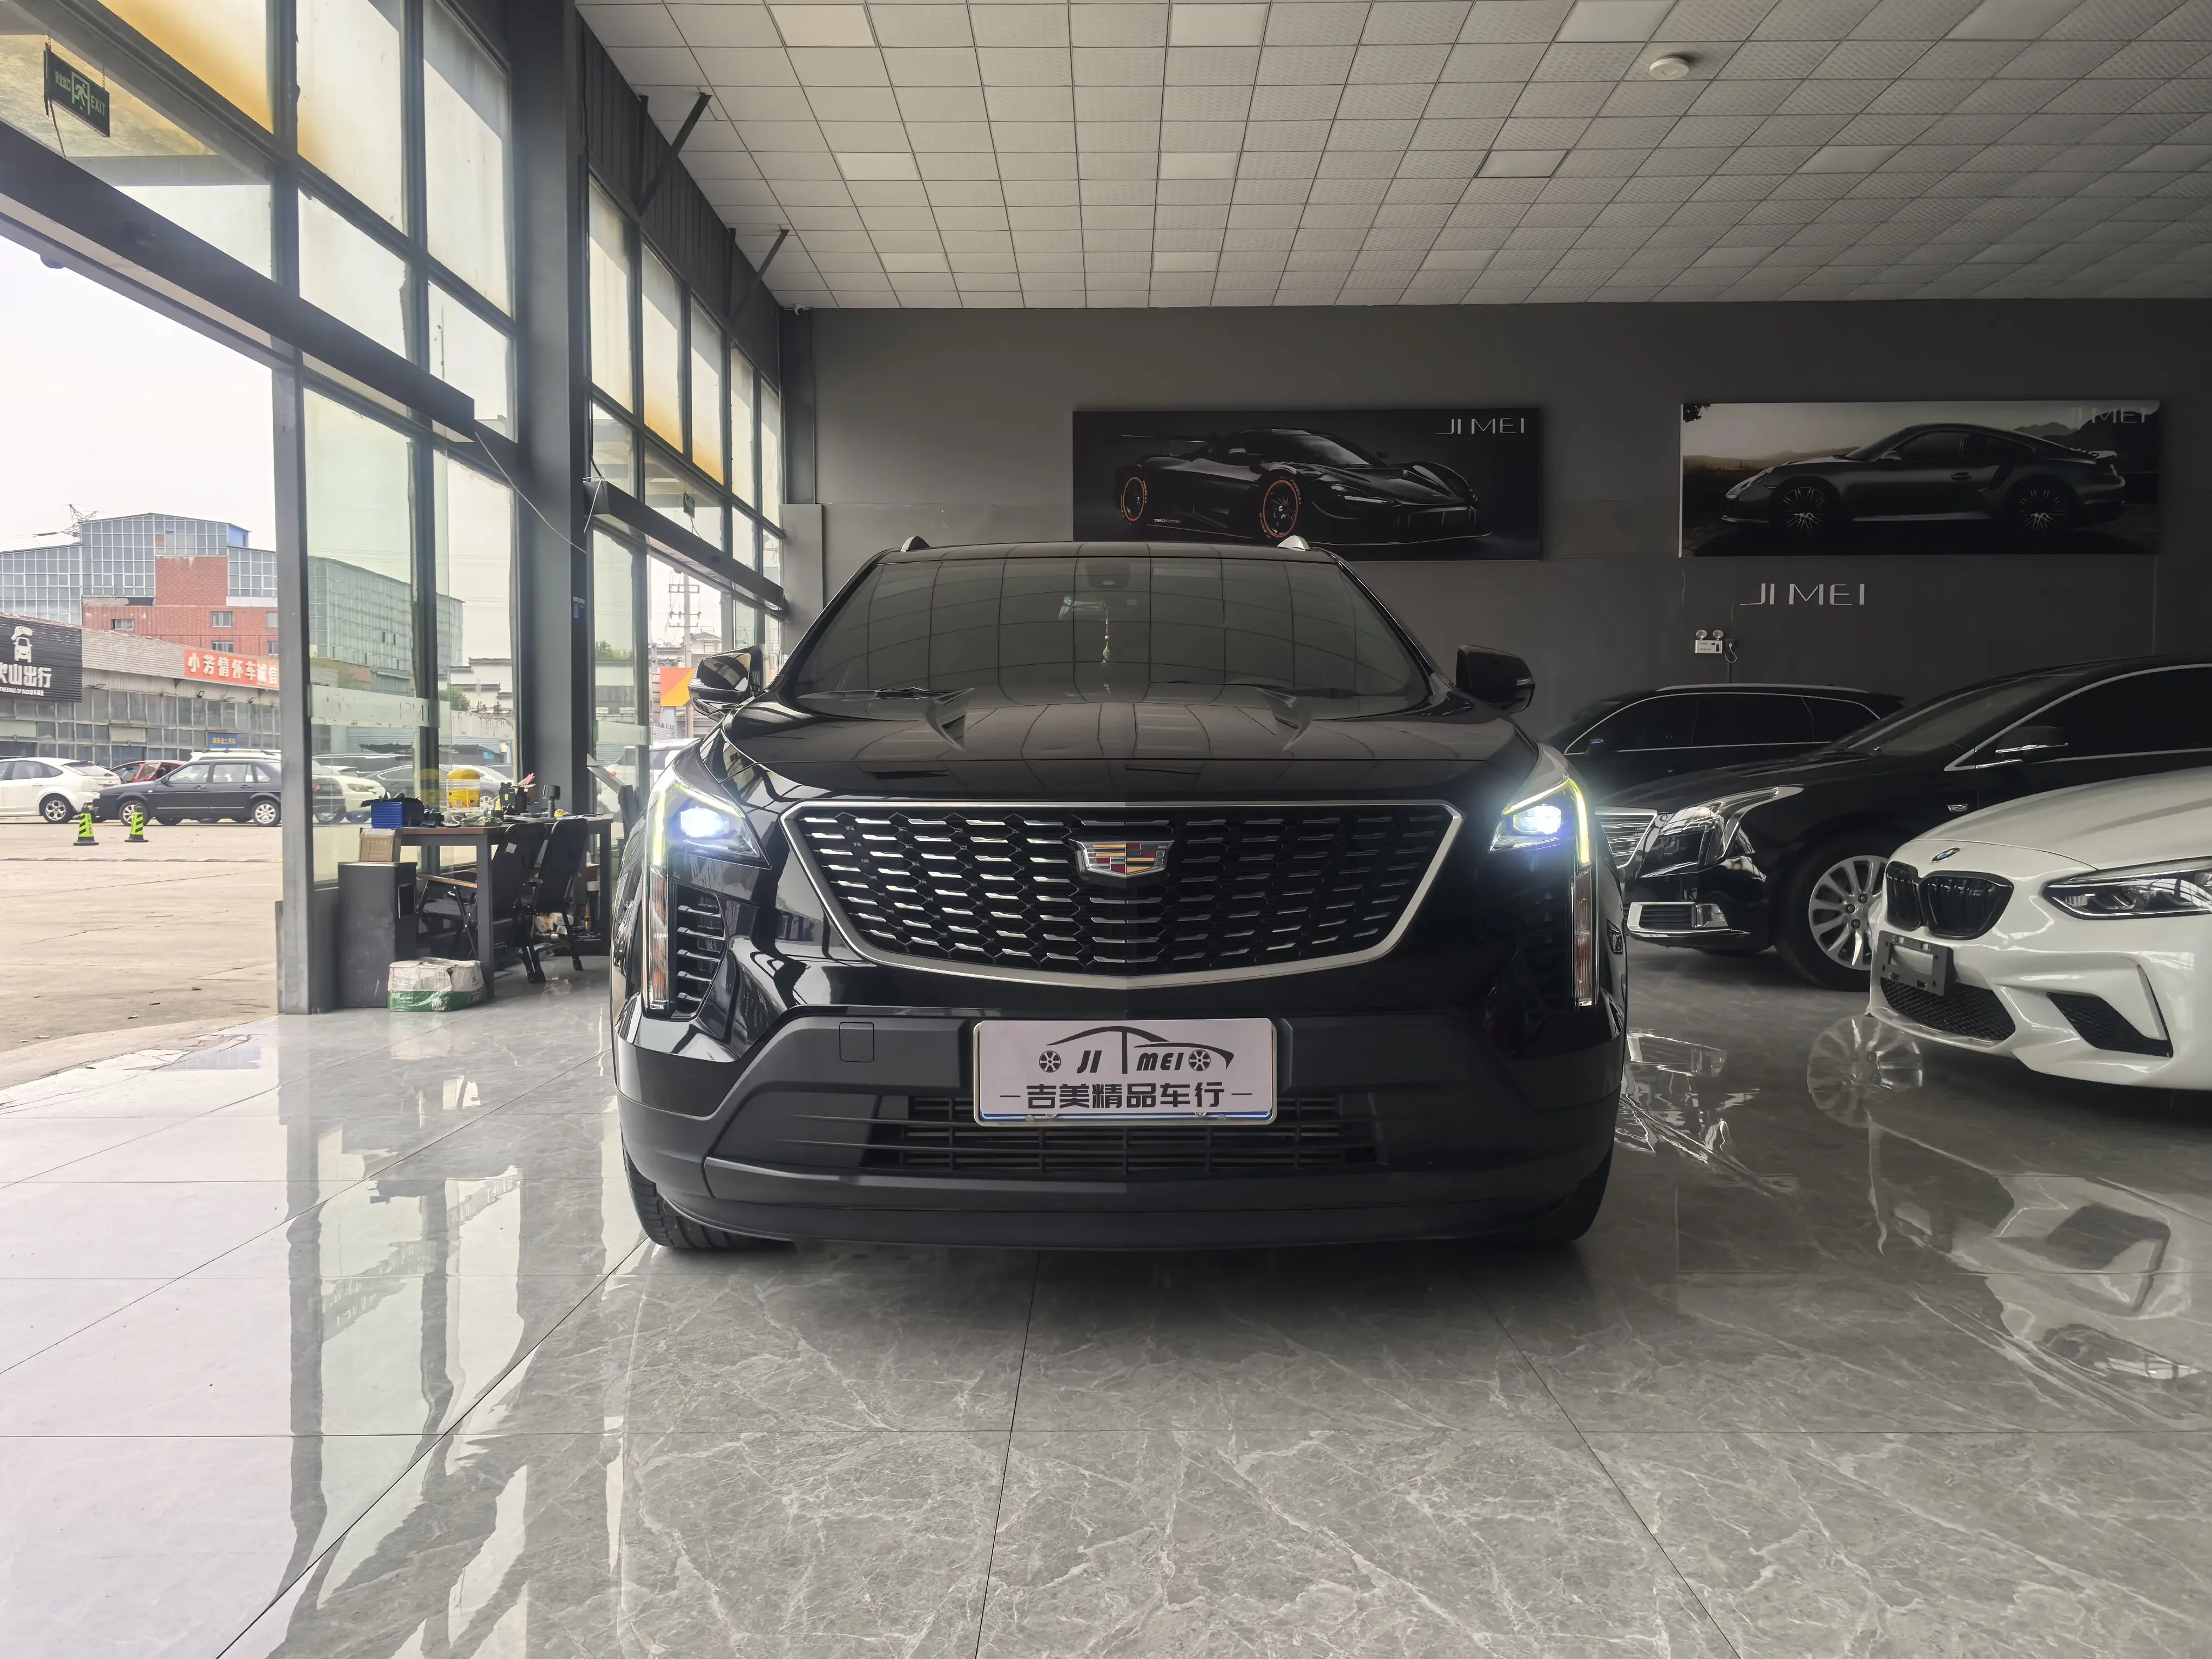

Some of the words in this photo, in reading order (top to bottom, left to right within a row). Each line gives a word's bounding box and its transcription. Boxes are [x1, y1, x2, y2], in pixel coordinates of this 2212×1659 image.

[91, 95, 105, 116] EXIT
[1435, 419, 1461, 435] JI
[1471, 417, 1525, 434] MEI
[1740, 583, 1775, 605] JI
[1789, 584, 1865, 605] MEI
[1076, 1050, 1102, 1074] JI
[1136, 1053, 1184, 1071] MEI
[1026, 1082, 1225, 1109] 吉美精品车行
